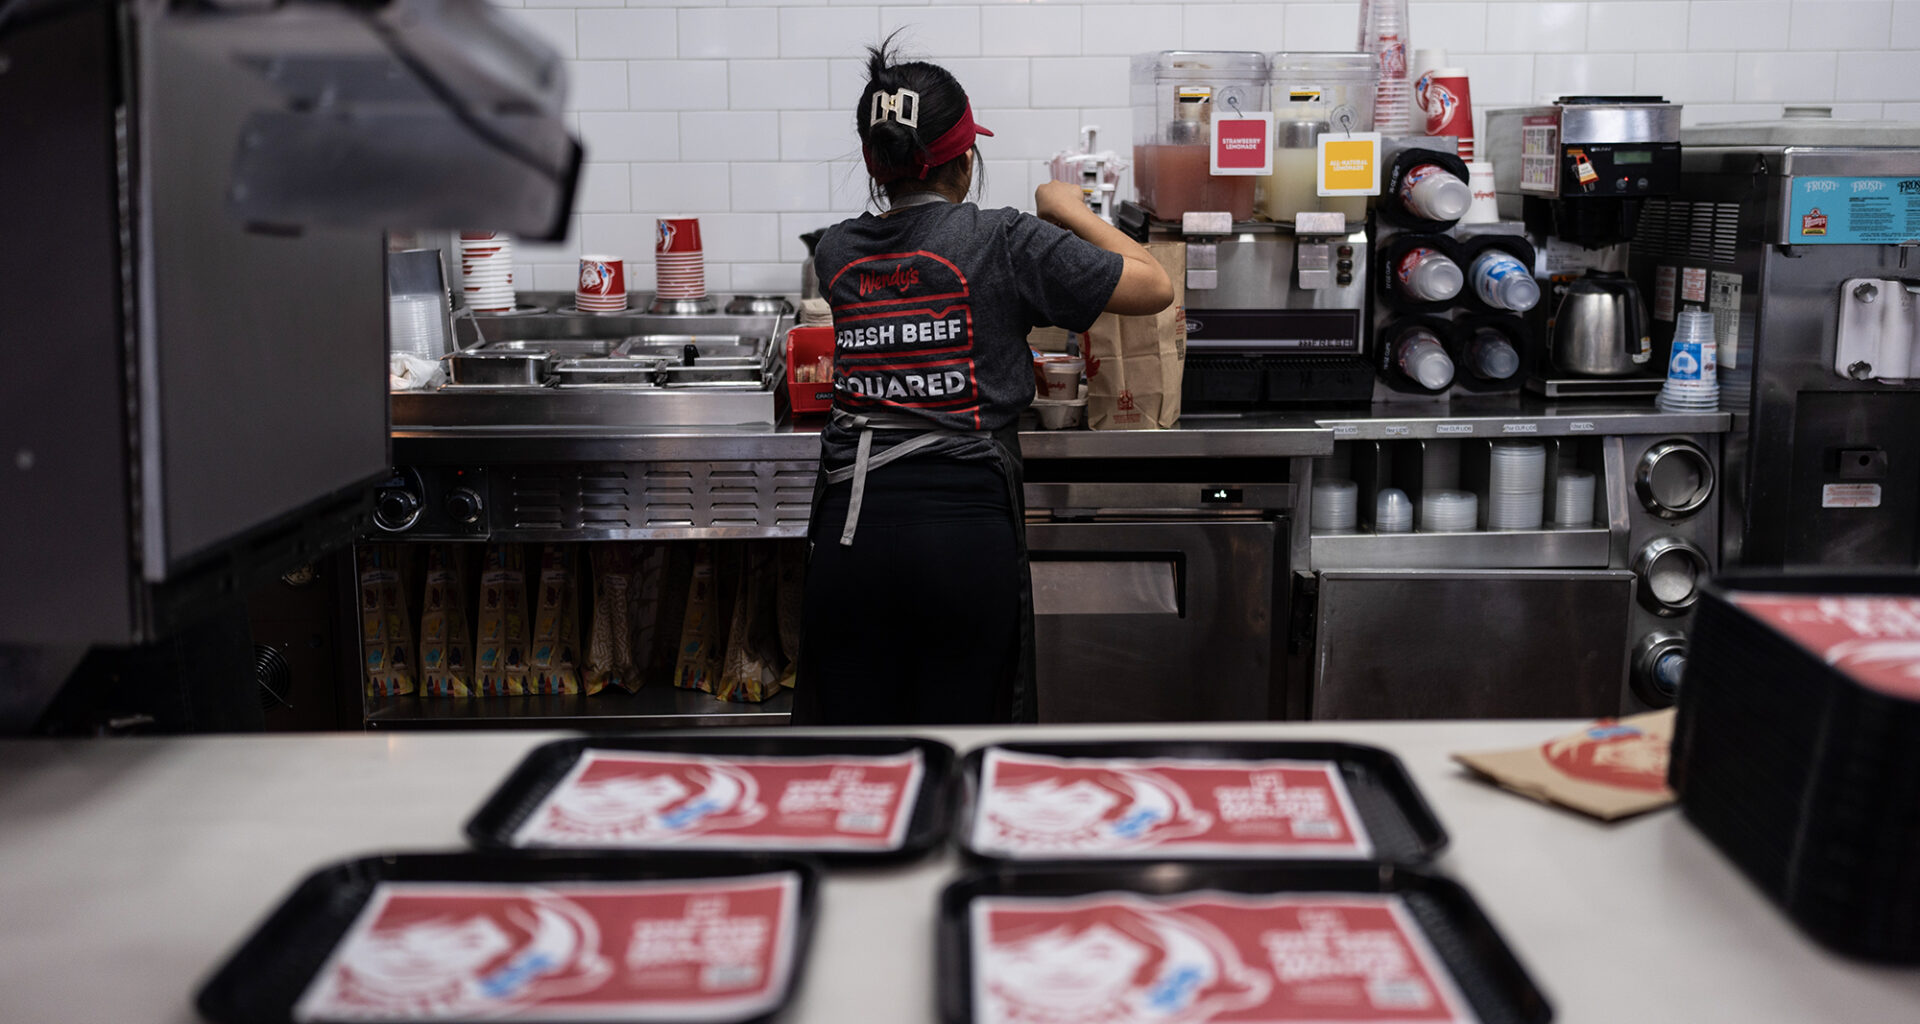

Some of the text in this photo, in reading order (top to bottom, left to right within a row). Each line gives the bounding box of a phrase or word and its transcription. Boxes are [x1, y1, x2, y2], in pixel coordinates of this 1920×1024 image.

[859, 264, 920, 297] Wendy's
[837, 319, 961, 348] FRESH BEEF
[835, 371, 966, 399] SQUARED
